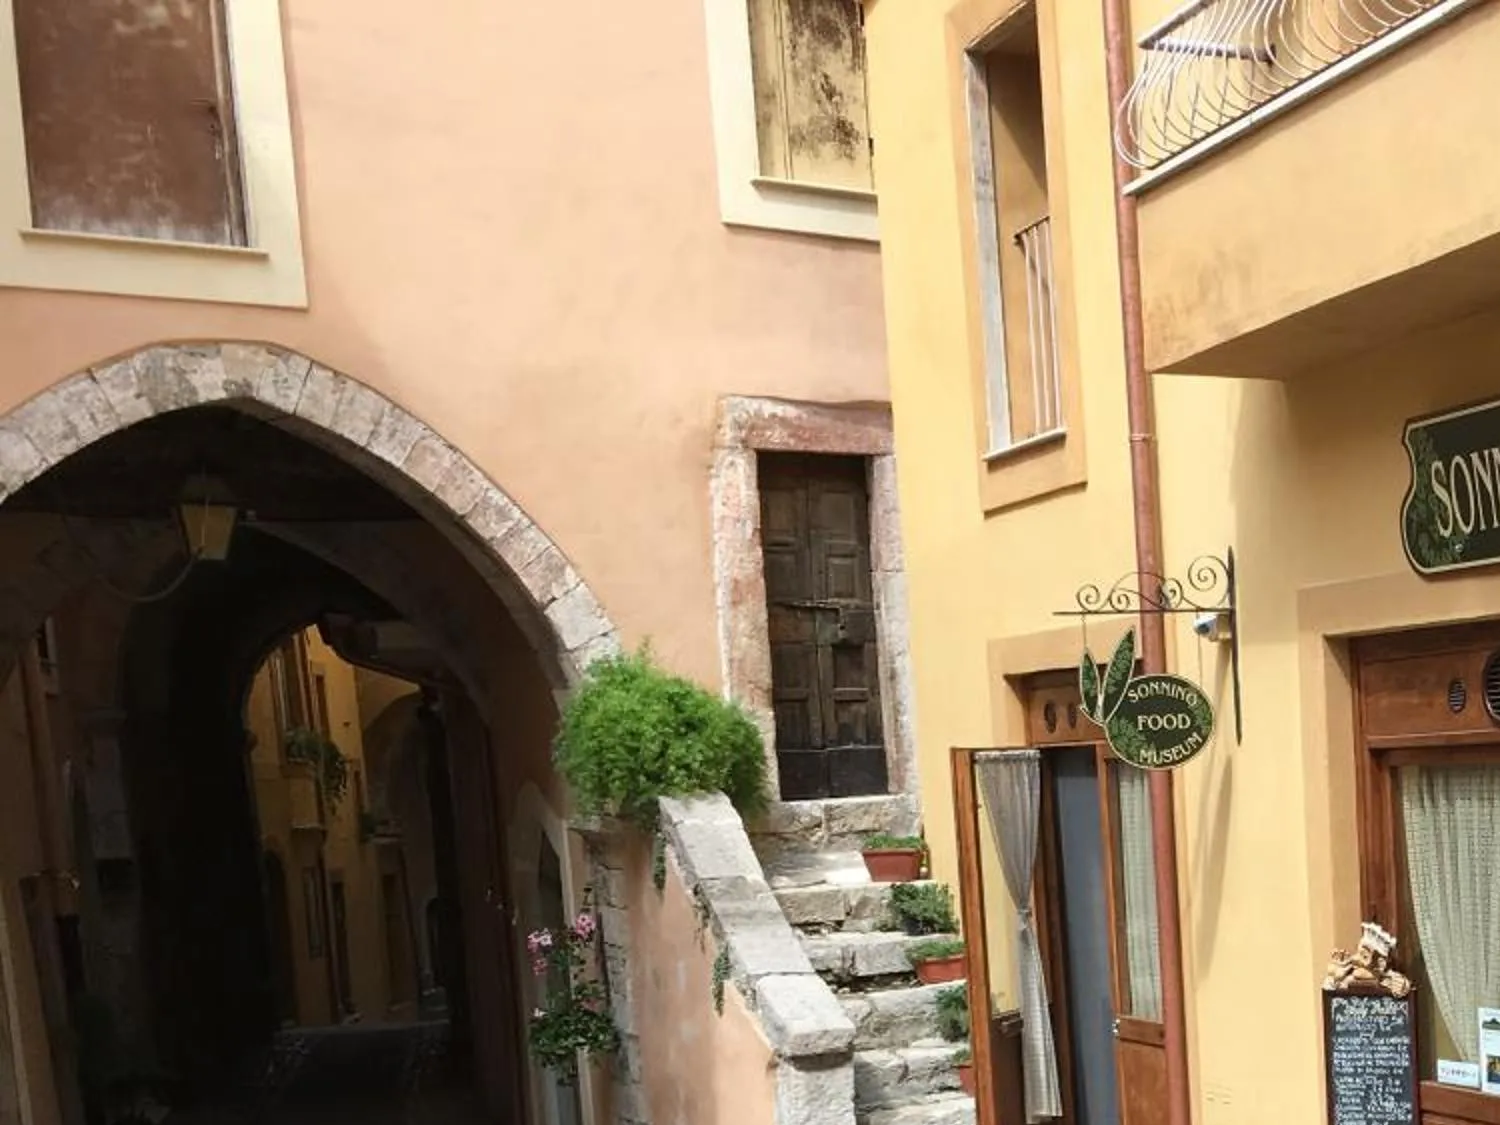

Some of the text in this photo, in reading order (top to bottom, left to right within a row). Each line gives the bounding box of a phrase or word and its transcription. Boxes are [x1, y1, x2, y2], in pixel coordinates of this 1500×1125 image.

[1128, 681, 1198, 706] SONNINO
[1137, 714, 1191, 731] FOOD
[1139, 732, 1203, 764] MUSEUM
